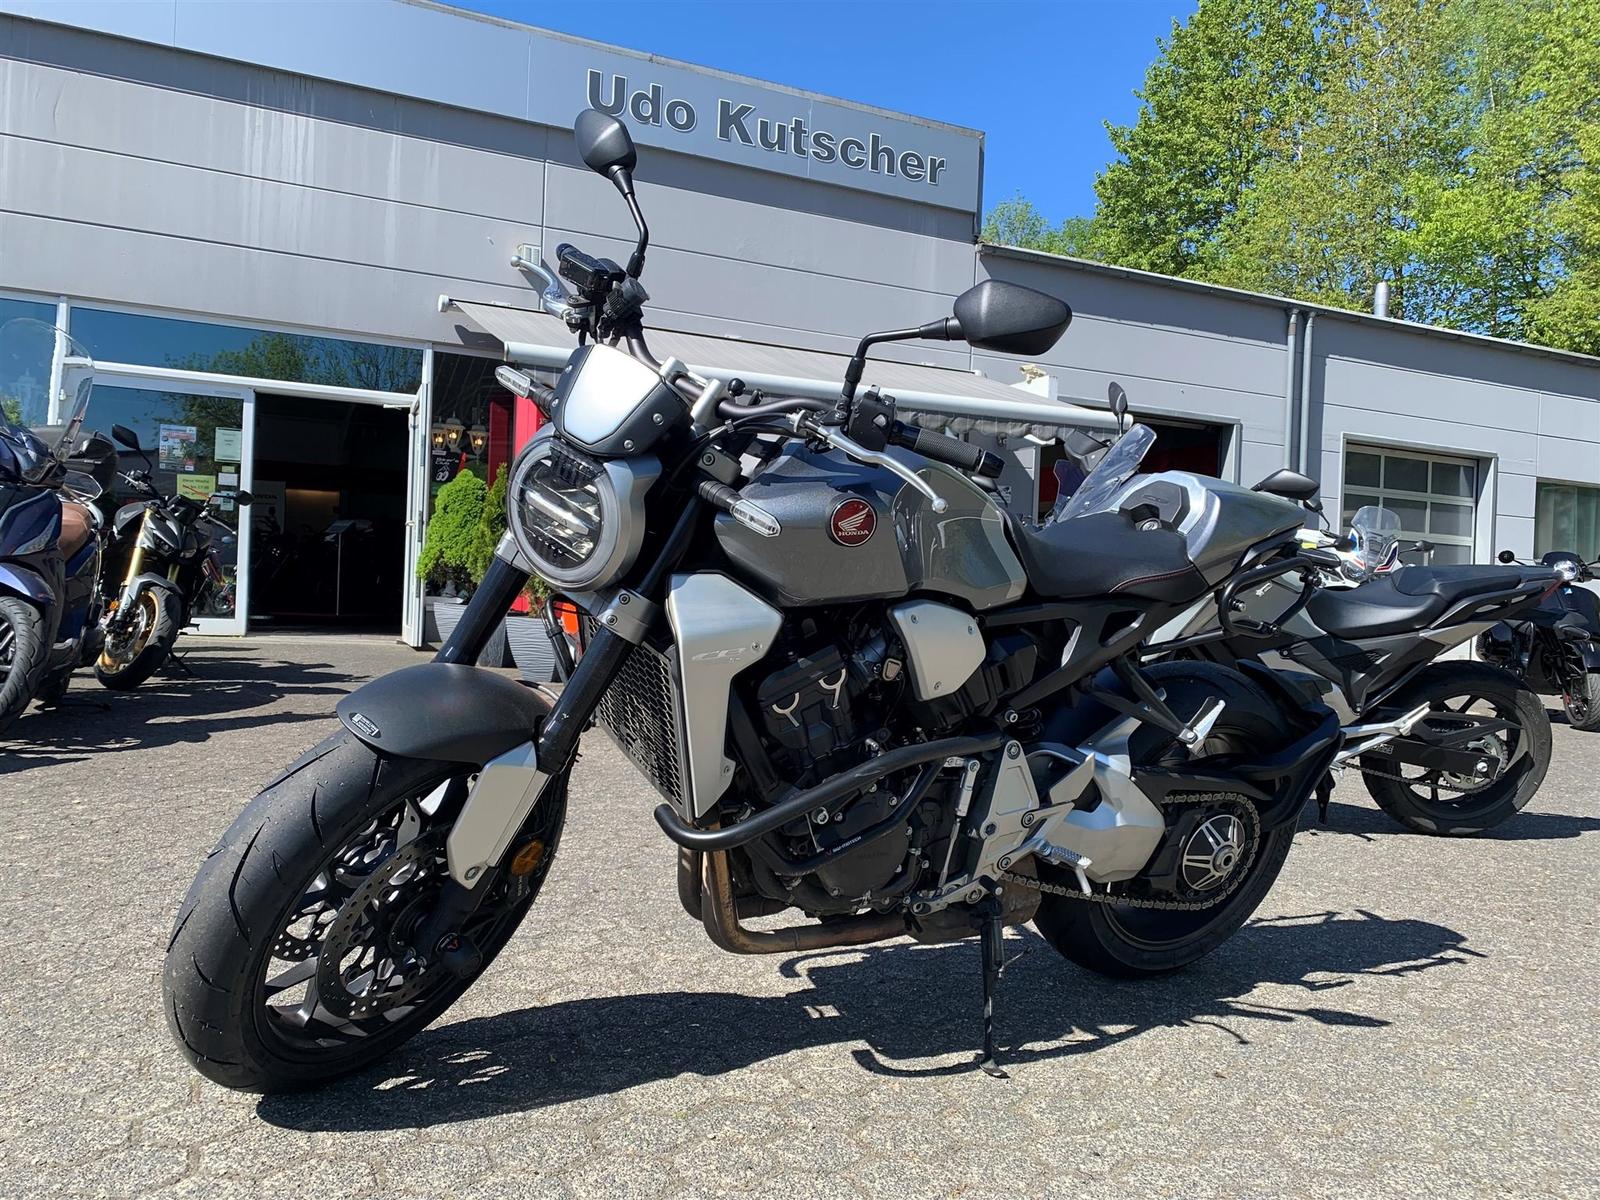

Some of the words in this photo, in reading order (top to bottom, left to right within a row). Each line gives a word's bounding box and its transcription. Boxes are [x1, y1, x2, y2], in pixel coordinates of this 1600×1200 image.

[586, 69, 697, 132] Udo
[716, 98, 946, 185] Kutscher
[838, 529, 869, 537] HONDA
